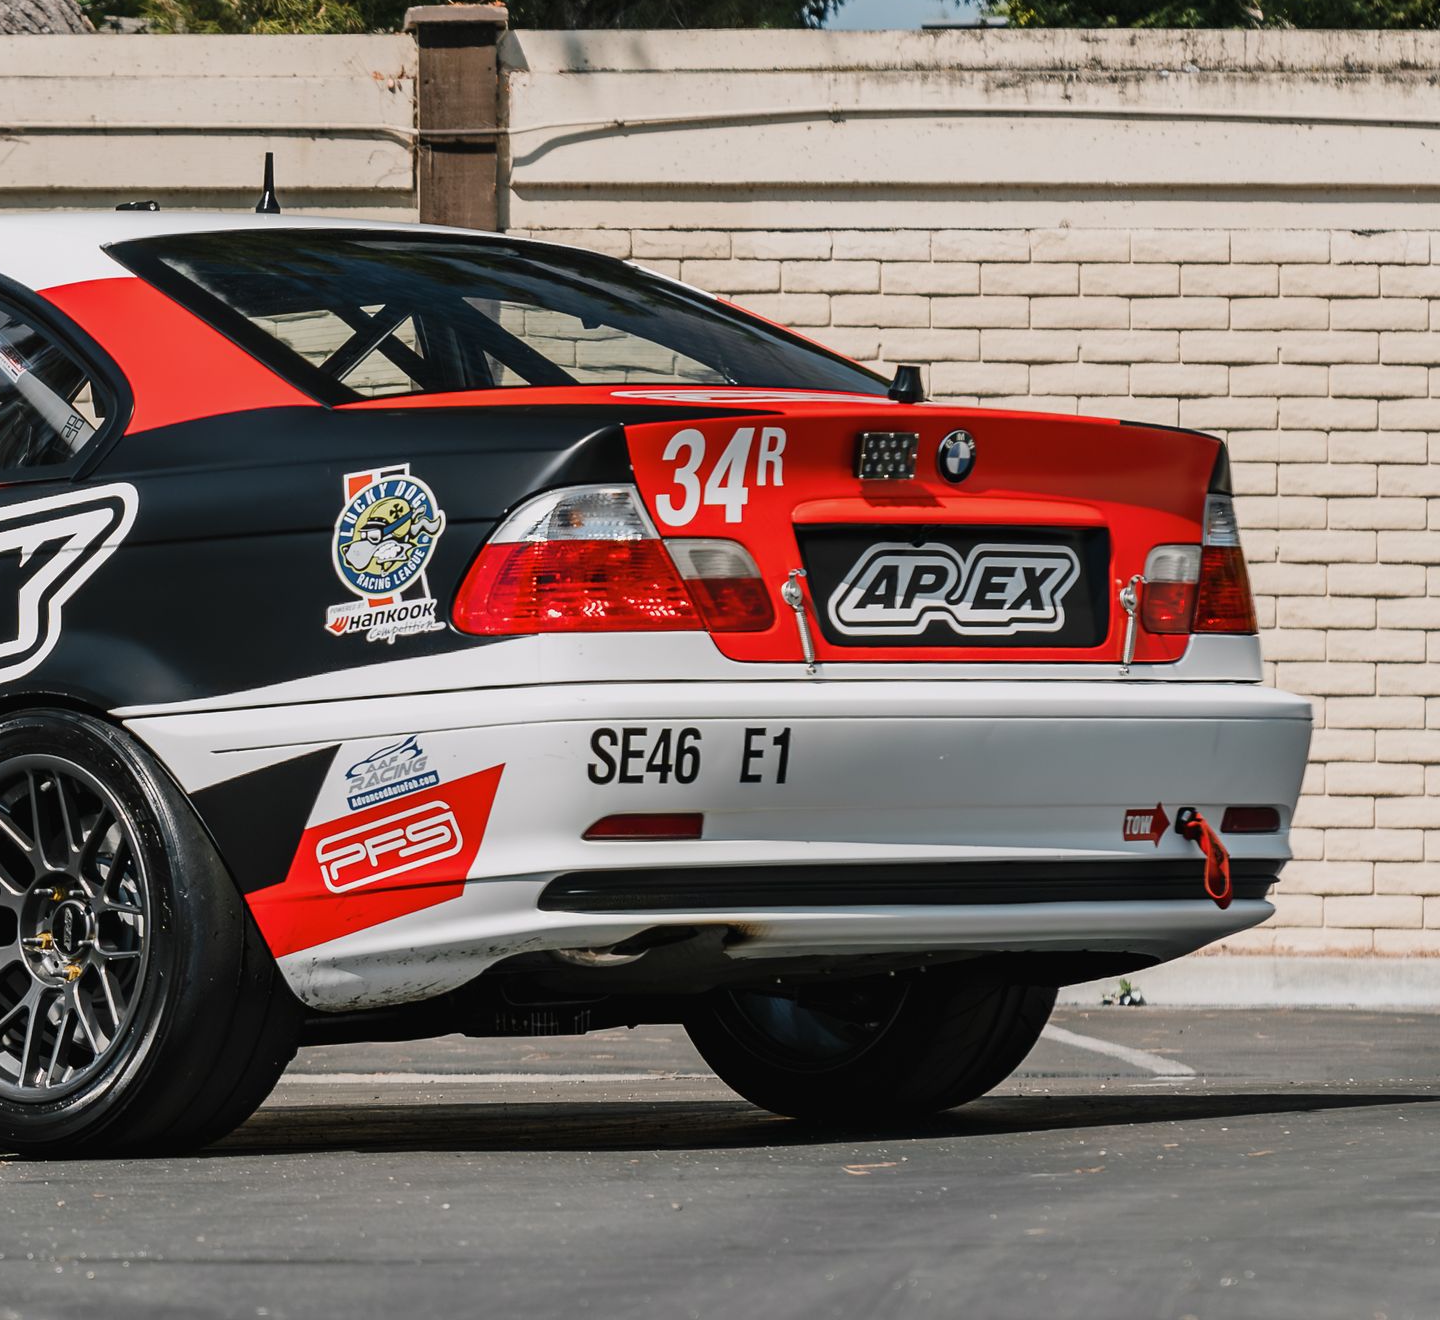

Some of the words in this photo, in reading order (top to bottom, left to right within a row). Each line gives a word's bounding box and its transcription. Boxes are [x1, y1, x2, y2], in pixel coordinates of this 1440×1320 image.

[340, 482, 388, 539] LUCKY
[394, 481, 427, 508] DOG
[357, 573, 392, 590] RACING
[394, 548, 426, 585] LEAGUE
[845, 556, 1064, 619] APEX
[349, 756, 428, 793] RACING
[365, 755, 398, 775] AAF
[588, 727, 701, 785] SE46
[740, 727, 791, 785] E1
[351, 774, 437, 808] AdvancedAutoFab.com
[318, 808, 456, 883] PFS
[1126, 815, 1154, 834] TOW
